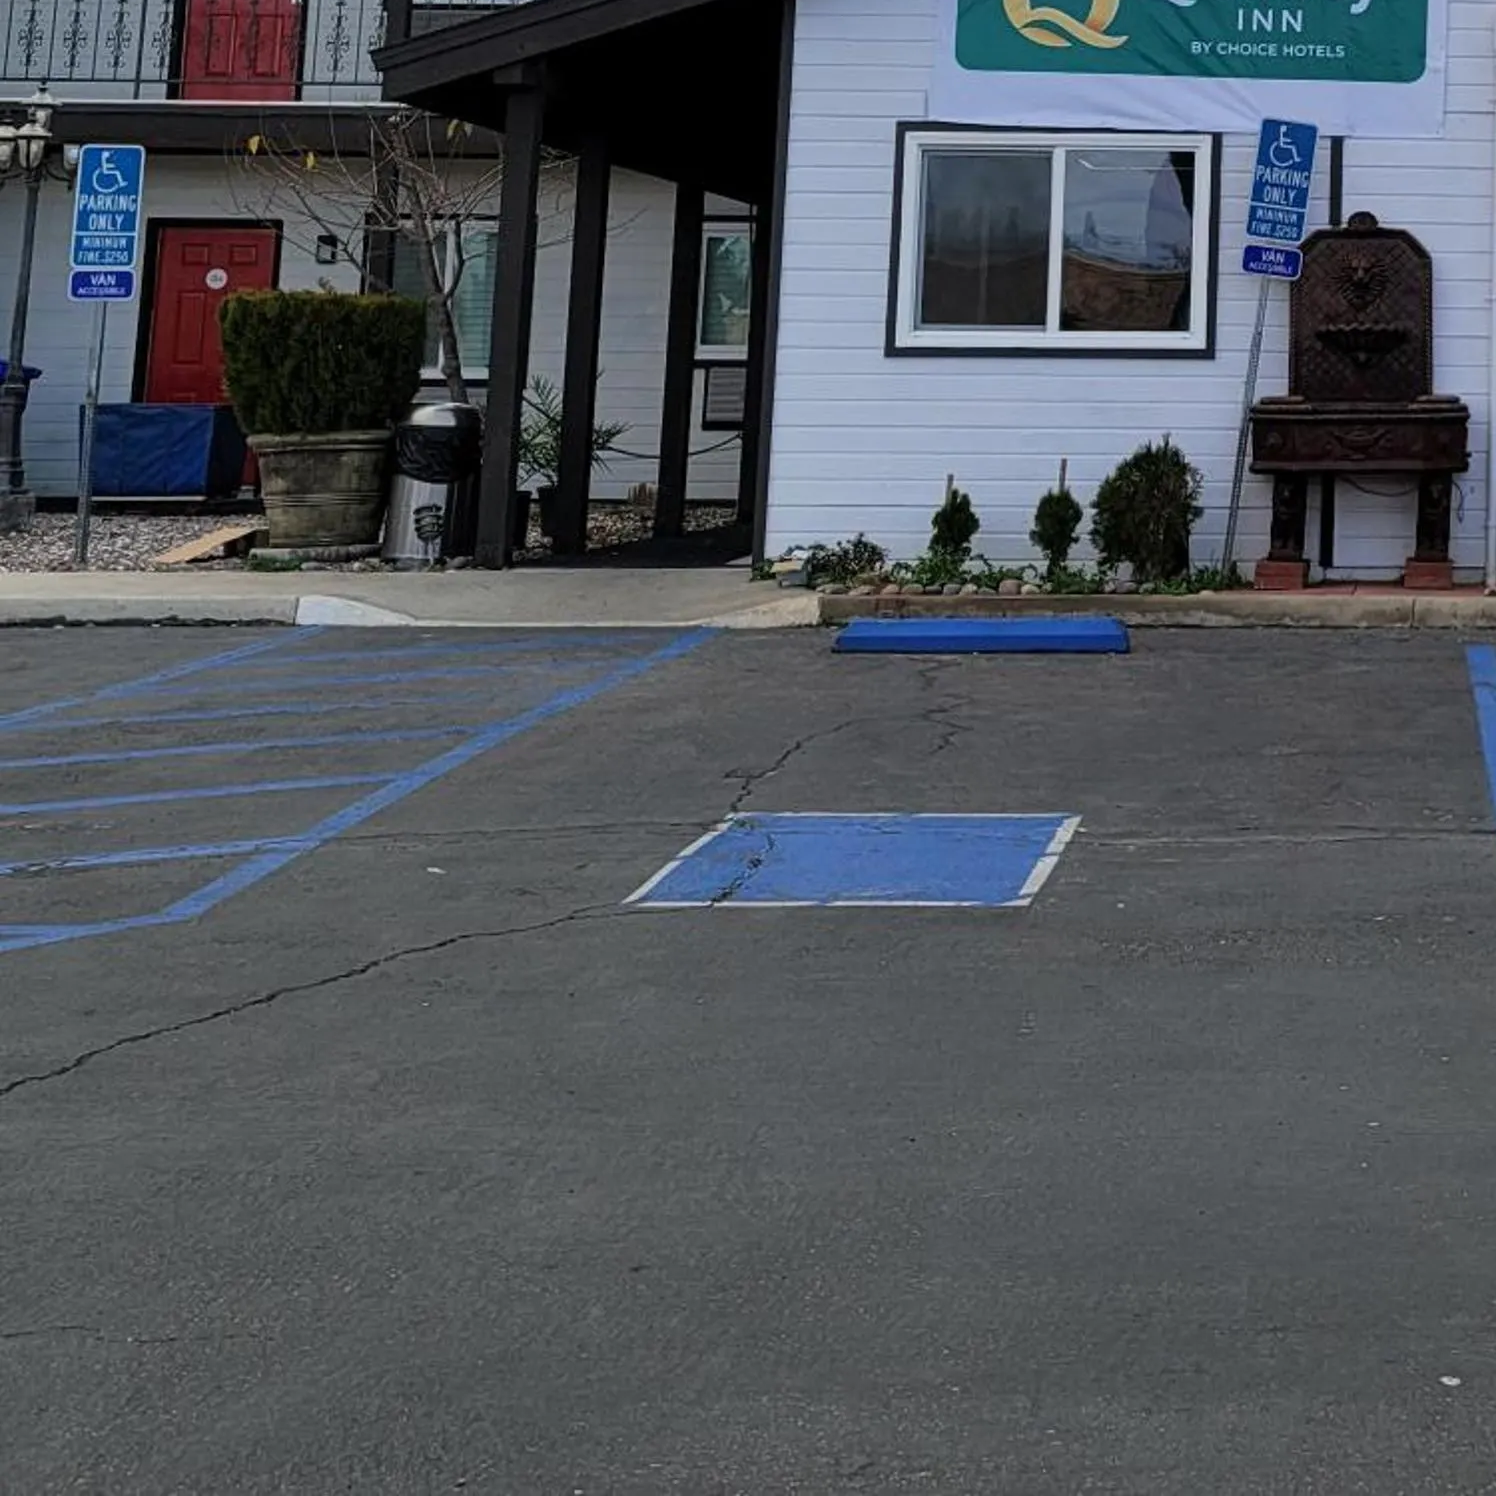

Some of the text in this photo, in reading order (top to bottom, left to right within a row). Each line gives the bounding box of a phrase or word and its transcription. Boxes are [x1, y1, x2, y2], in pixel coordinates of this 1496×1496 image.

[1236, 8, 1305, 33] INN
[1190, 41, 1346, 58] BY CHOICE HOTELS
[1256, 165, 1310, 188] PARKING
[78, 194, 137, 212] PARKING
[1263, 185, 1298, 207] ONLY
[88, 213, 125, 230] ONLY
[1261, 249, 1286, 264] VAN
[89, 272, 116, 286] VAN
